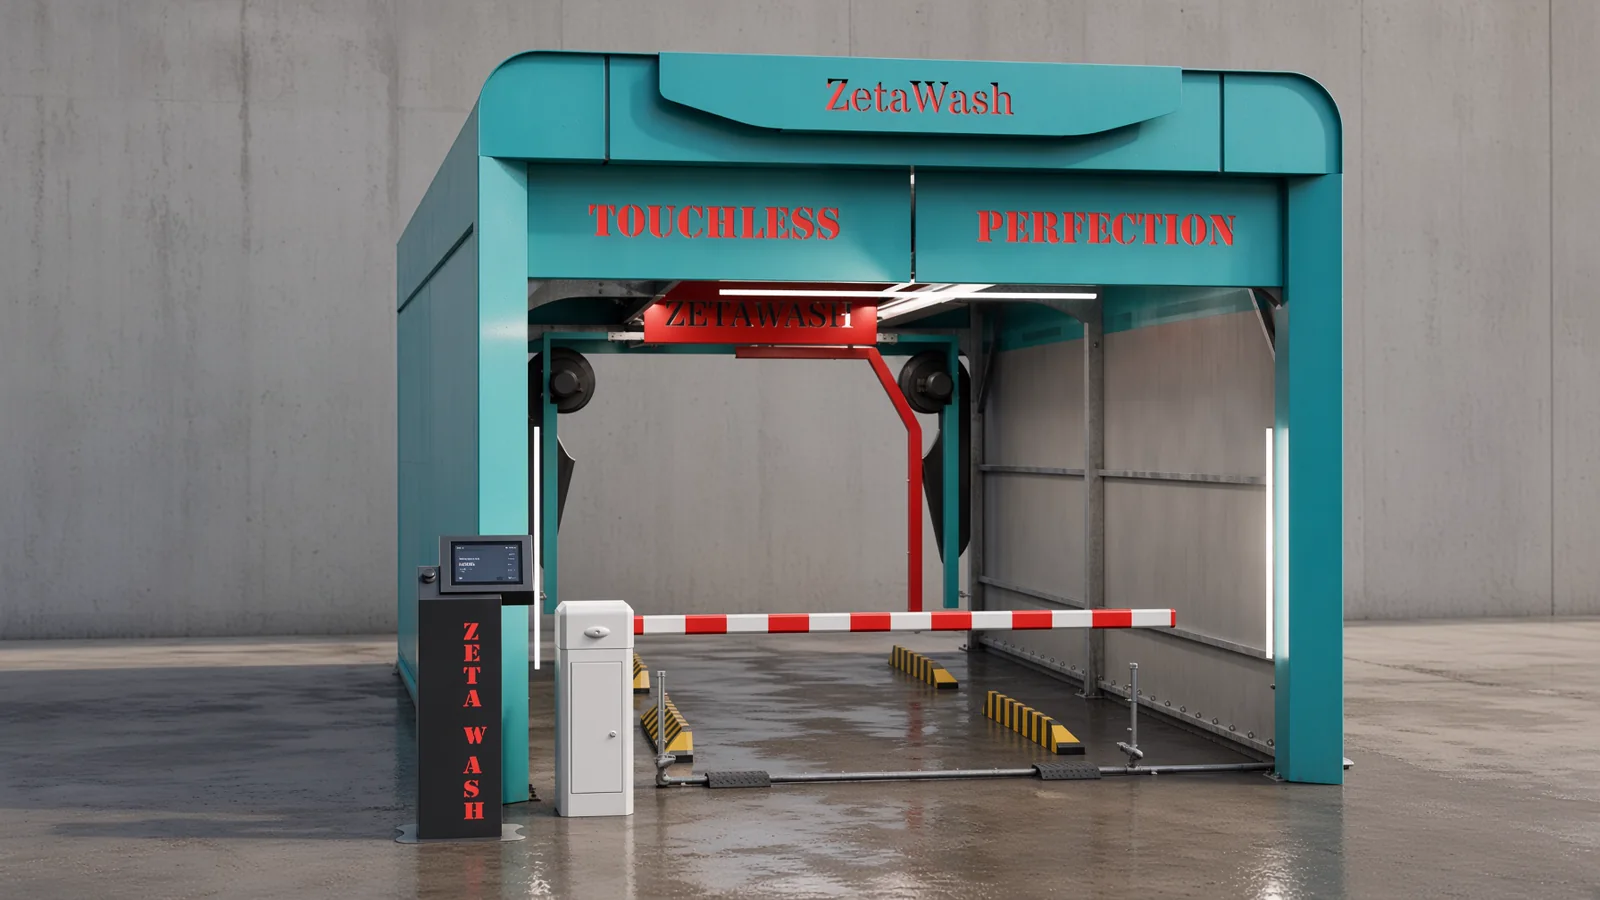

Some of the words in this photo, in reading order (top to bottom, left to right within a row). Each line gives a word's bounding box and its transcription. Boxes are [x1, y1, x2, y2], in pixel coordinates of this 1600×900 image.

[825, 77, 1015, 116] ZetaWash
[588, 203, 841, 241] TOUCHLESS
[976, 209, 1236, 246] PERFECTION
[665, 299, 854, 329] ZETAWASH
